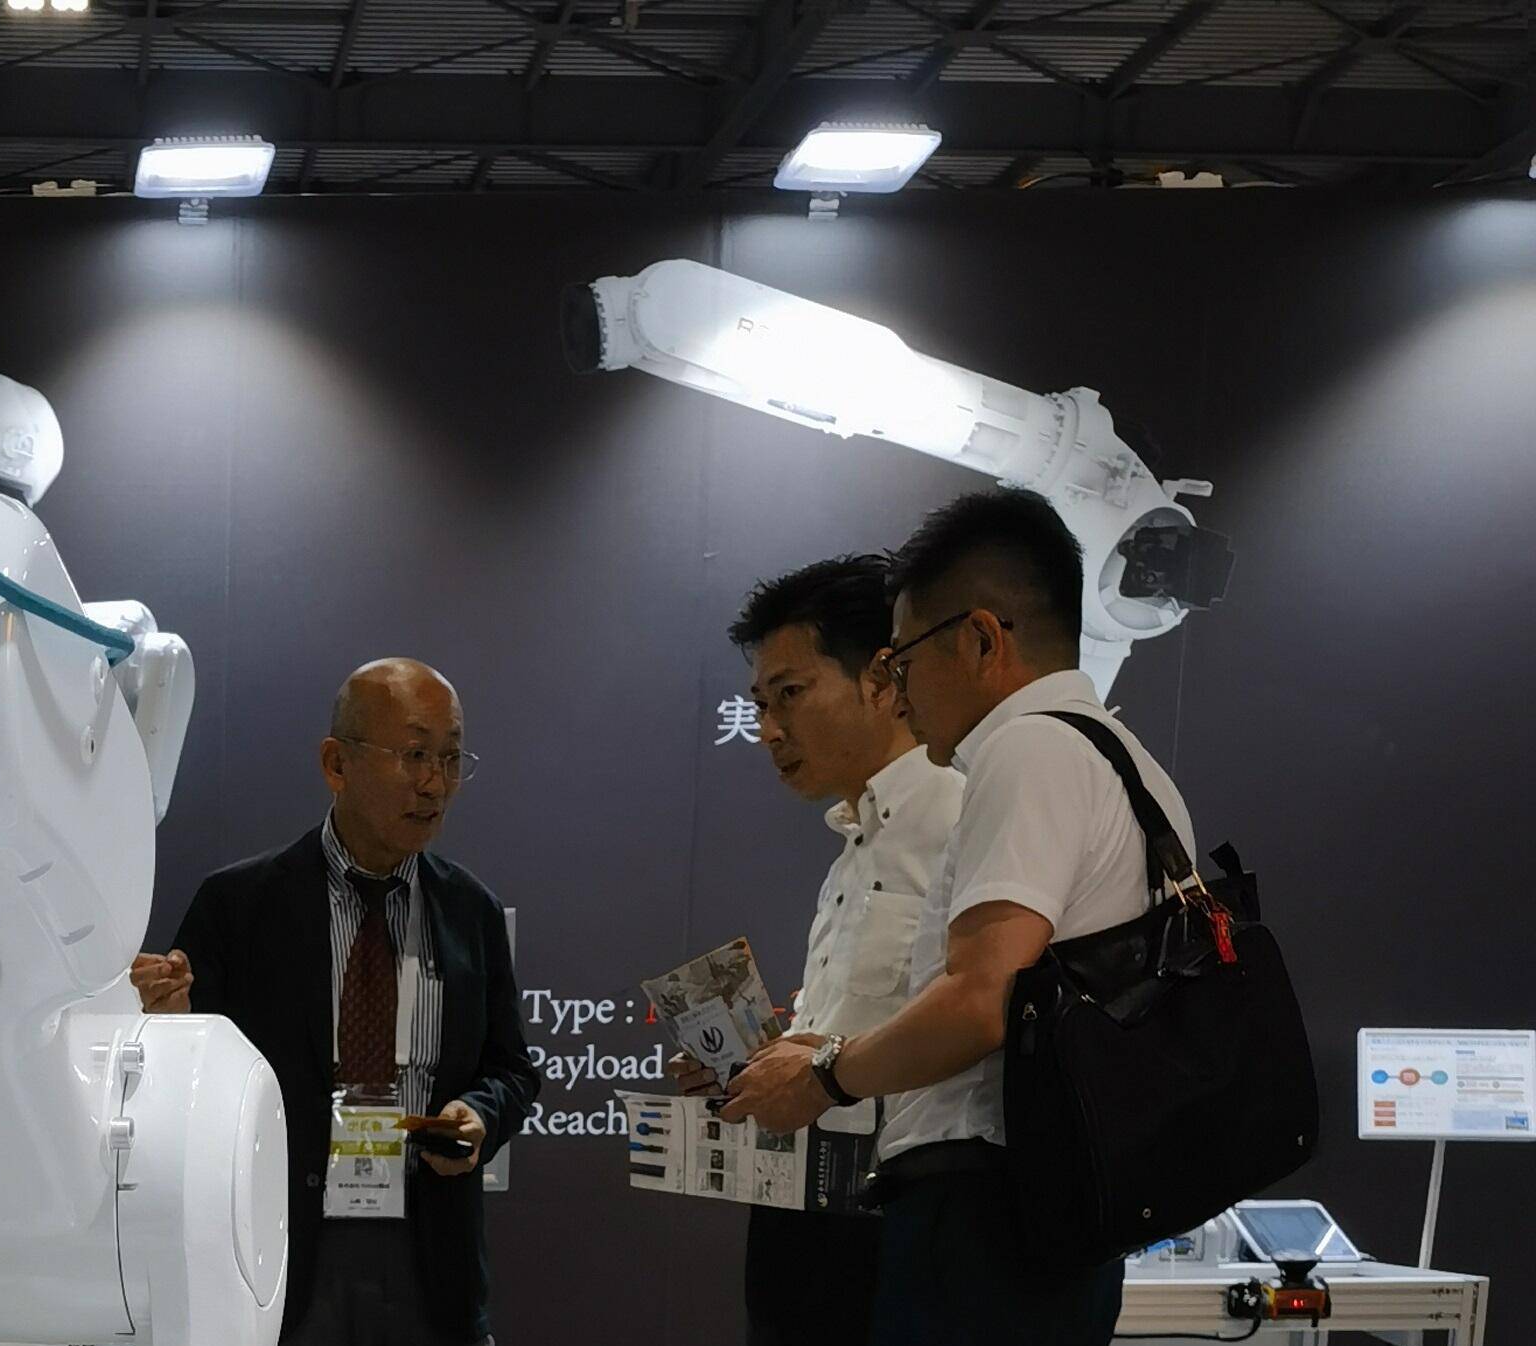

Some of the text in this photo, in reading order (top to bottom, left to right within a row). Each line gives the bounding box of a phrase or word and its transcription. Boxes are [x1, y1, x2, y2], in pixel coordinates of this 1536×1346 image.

[714, 695, 762, 746] 実
[522, 989, 615, 1034] Type
[519, 1101, 628, 1135] Reach
